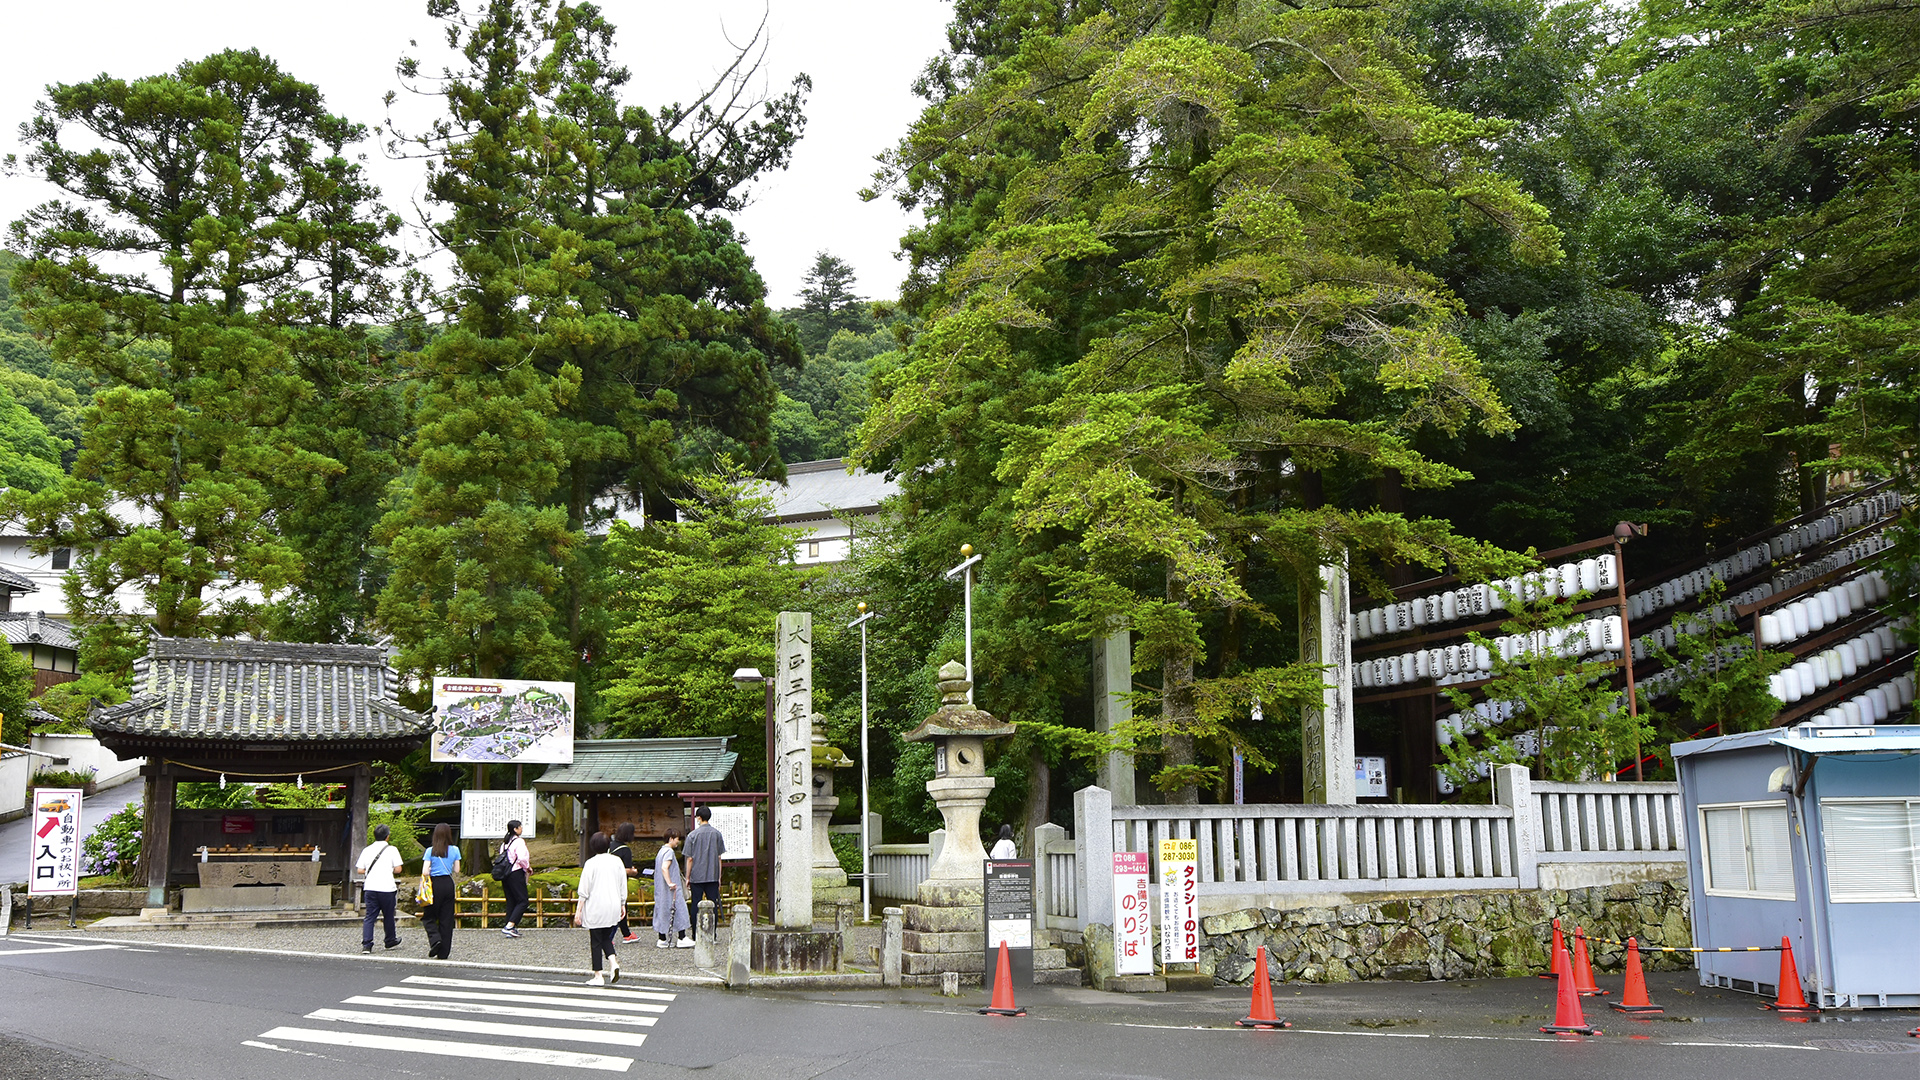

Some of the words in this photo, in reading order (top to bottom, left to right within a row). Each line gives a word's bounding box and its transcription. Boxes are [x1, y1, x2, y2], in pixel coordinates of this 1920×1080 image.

[785, 625, 808, 831] 大正三年一月四日
[36, 845, 57, 879] 入口
[1123, 854, 1136, 862] 086
[1163, 852, 1195, 861] 287-3030
[1122, 894, 1138, 957] のりば
[1137, 879, 1148, 946] 吉備タクシー
[1184, 865, 1197, 959] タクシーのりば
